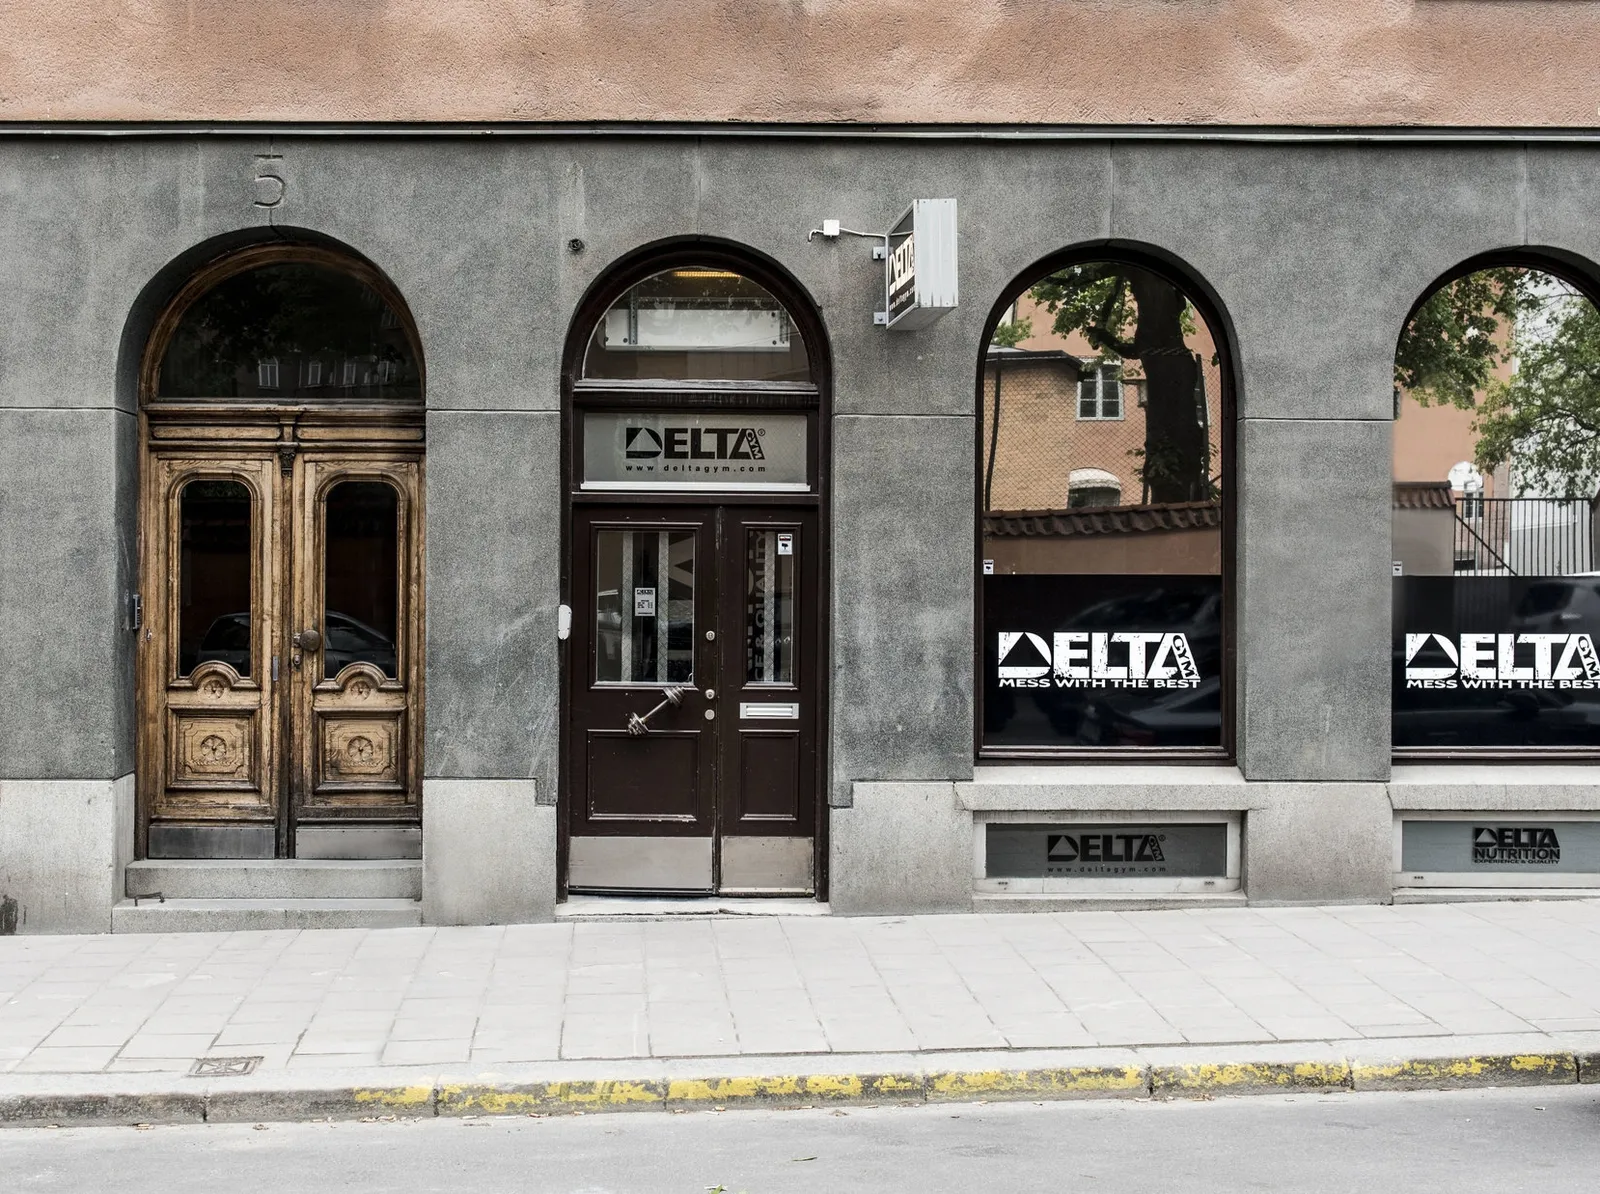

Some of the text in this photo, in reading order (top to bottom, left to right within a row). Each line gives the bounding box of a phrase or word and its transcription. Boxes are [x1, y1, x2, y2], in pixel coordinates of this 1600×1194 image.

[253, 154, 286, 209] 5
[626, 427, 765, 460] DELTA
[744, 428, 763, 459] GYM
[998, 631, 1201, 680] DELTA
[1172, 634, 1196, 678] GYM
[1405, 633, 1600, 680] DELTA
[1578, 635, 1600, 678] GYM
[998, 678, 1201, 688] MESS WITH THE BEST
[1406, 679, 1458, 689] MESS
[1462, 679, 1513, 689] WITH
[1520, 679, 1555, 689] THE
[1047, 834, 1165, 862] DELTA
[1148, 835, 1163, 861] GYM
[1474, 827, 1560, 848] DELTA
[1474, 848, 1561, 859] NUTRITION
[1047, 866, 1166, 874] www.deltagym.com
